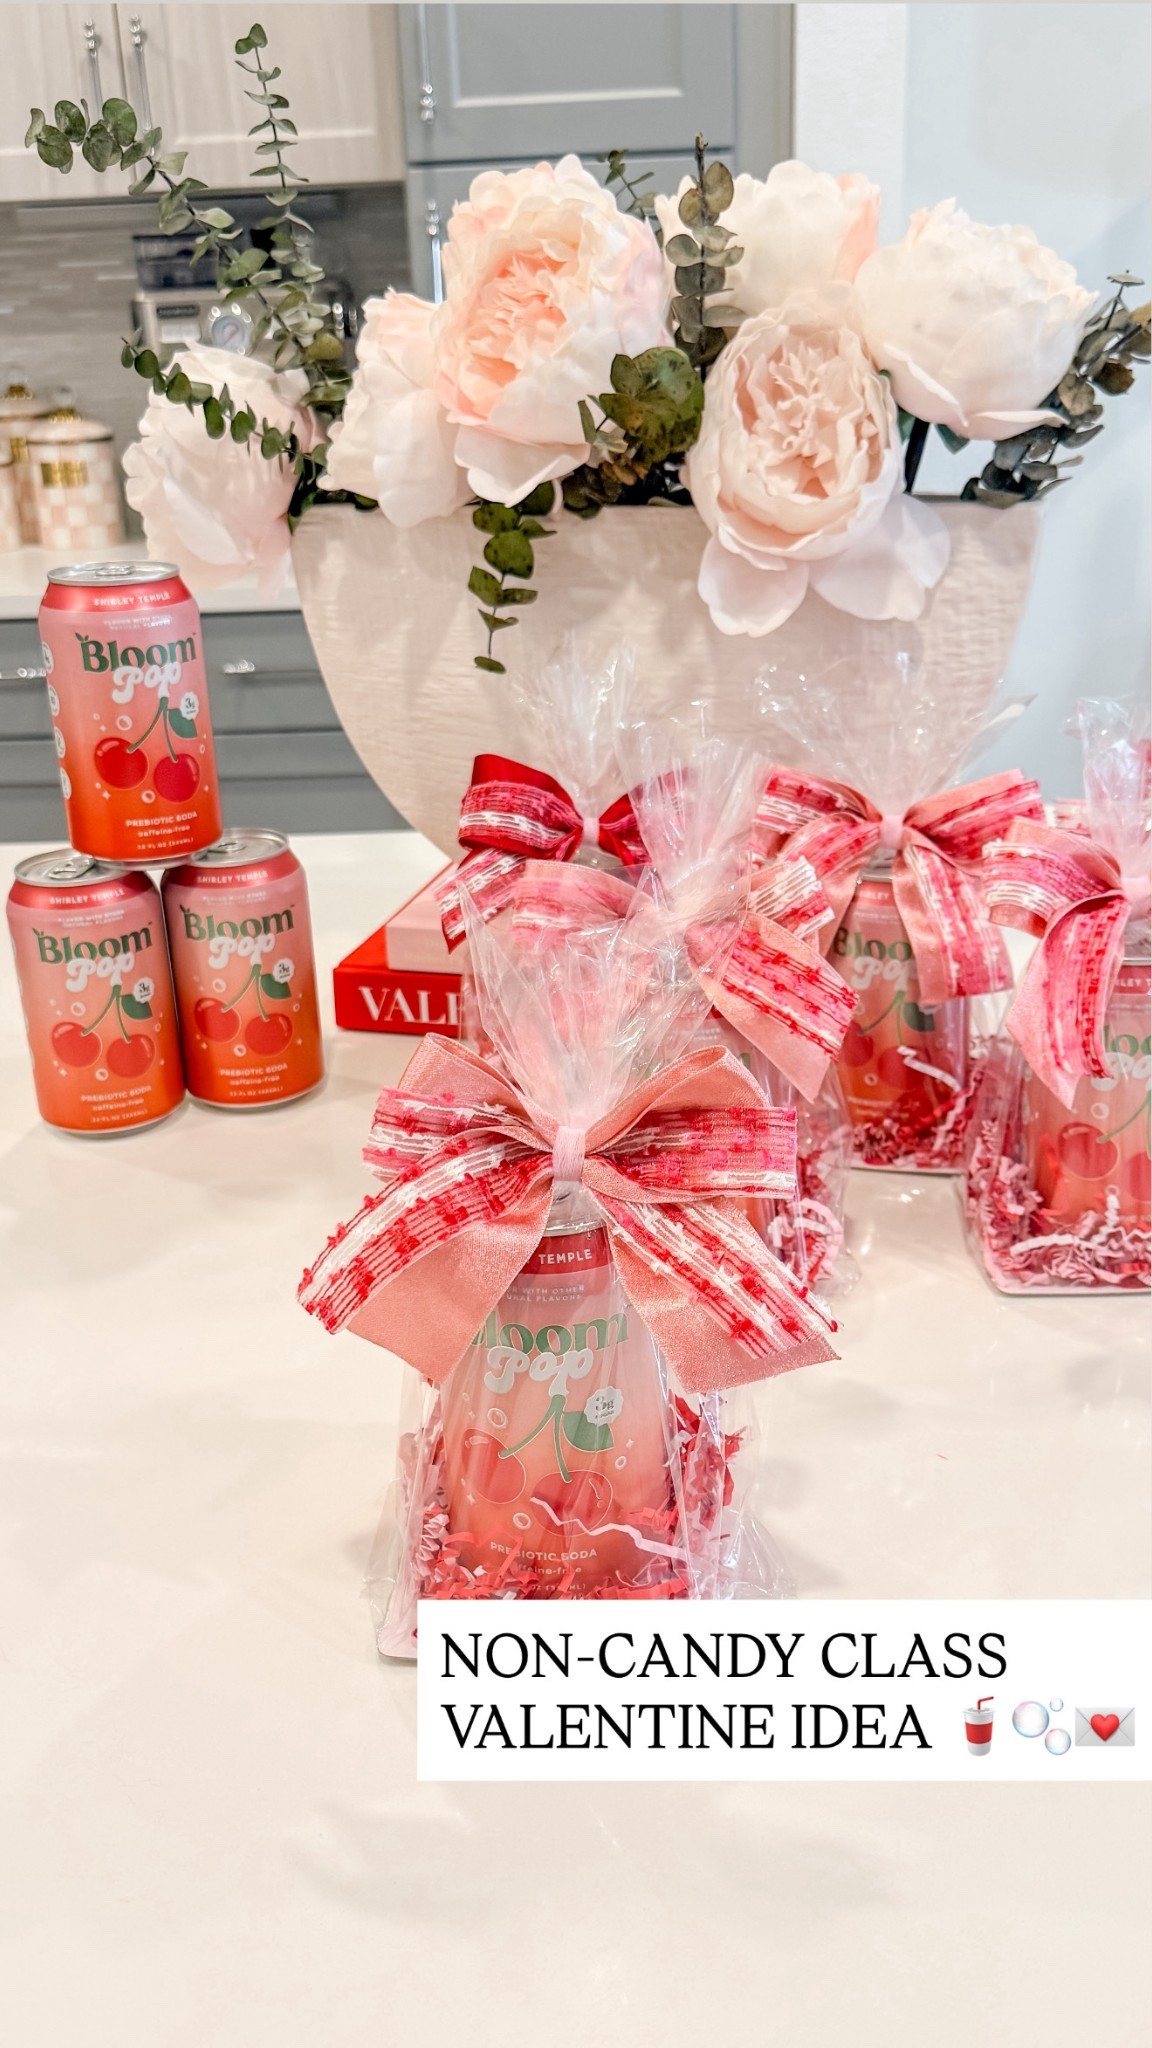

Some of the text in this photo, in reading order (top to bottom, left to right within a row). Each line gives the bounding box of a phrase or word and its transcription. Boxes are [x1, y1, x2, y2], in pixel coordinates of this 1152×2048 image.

[94, 592, 171, 606] SHIRLEY TEMPLE
[80, 636, 197, 673] Bloom
[112, 661, 182, 703] Pop
[126, 811, 198, 827] PREBIOTIC SODA
[138, 825, 191, 838] caffeine-free
[197, 870, 268, 883] SHIRLEY TEMPLE
[50, 888, 125, 905] SHIRLEY TEMPLE
[184, 908, 294, 941] Bloom
[37, 927, 153, 965] Bloom
[208, 932, 276, 970] Pop
[65, 951, 135, 993] Pop
[220, 1067, 264, 1077] PREBIOTIC
[81, 1092, 128, 1102] PREBIOTIC
[538, 1248, 593, 1265] TEMPLE
[552, 1284, 585, 1295] OTHER
[473, 1311, 630, 1356] loom
[483, 1345, 594, 1396] Pop
[560, 1548, 598, 1561] SODA
